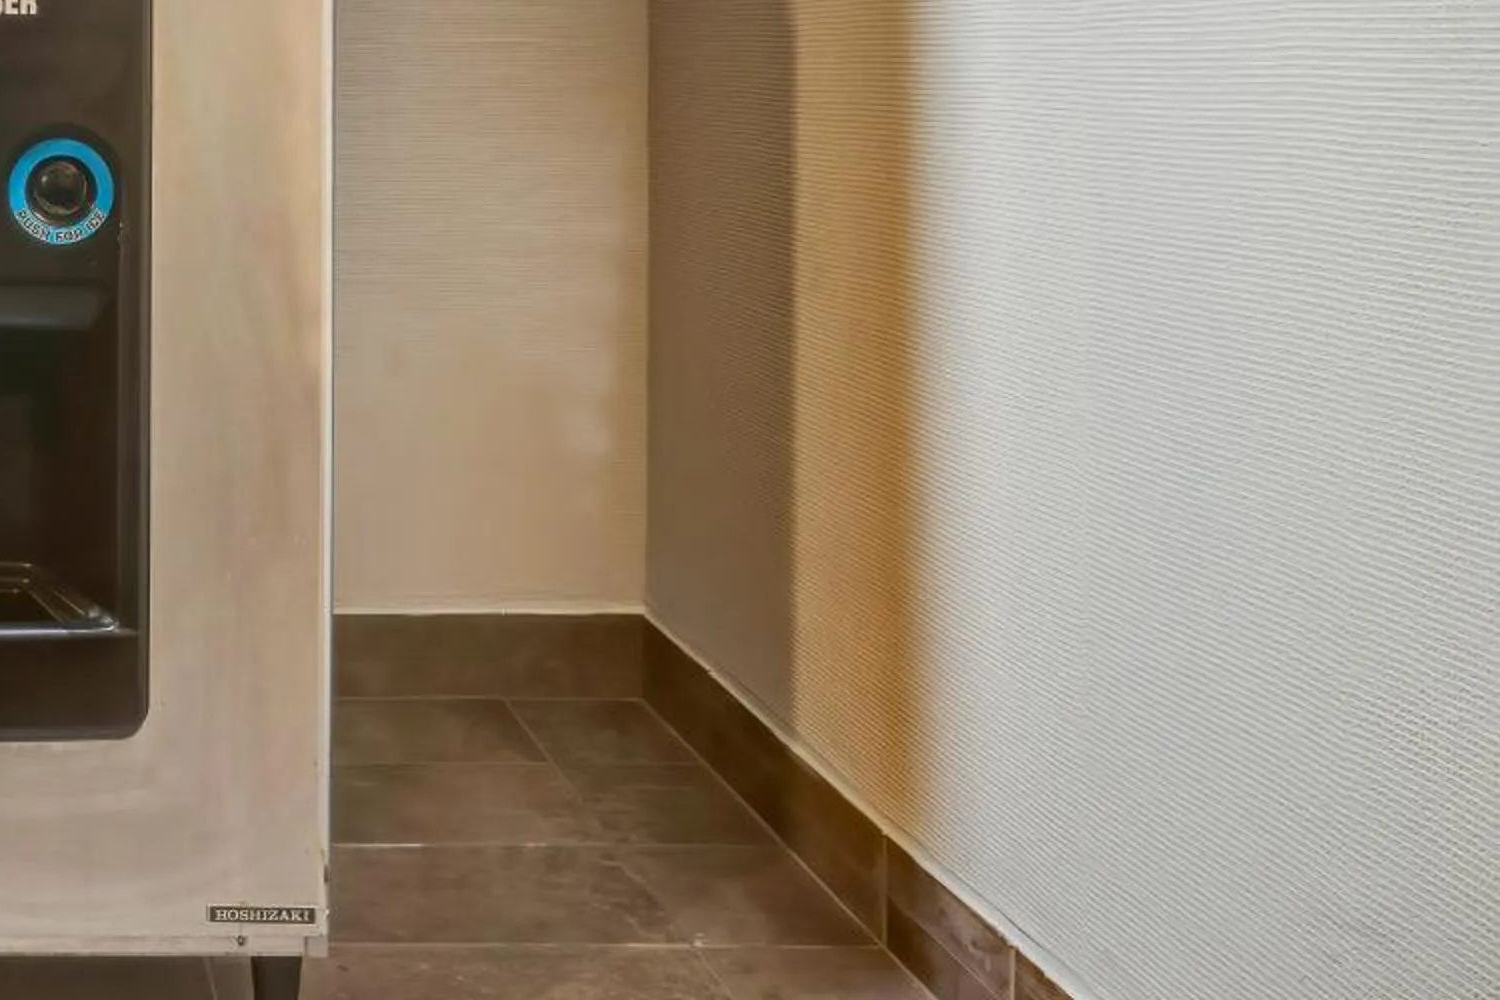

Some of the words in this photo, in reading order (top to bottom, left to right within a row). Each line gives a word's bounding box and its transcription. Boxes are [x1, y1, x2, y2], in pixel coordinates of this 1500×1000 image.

[17, 208, 51, 241] PUSH
[54, 227, 83, 242] FOR
[85, 208, 107, 231] ICE
[215, 908, 310, 921] HOSHIZAKI
